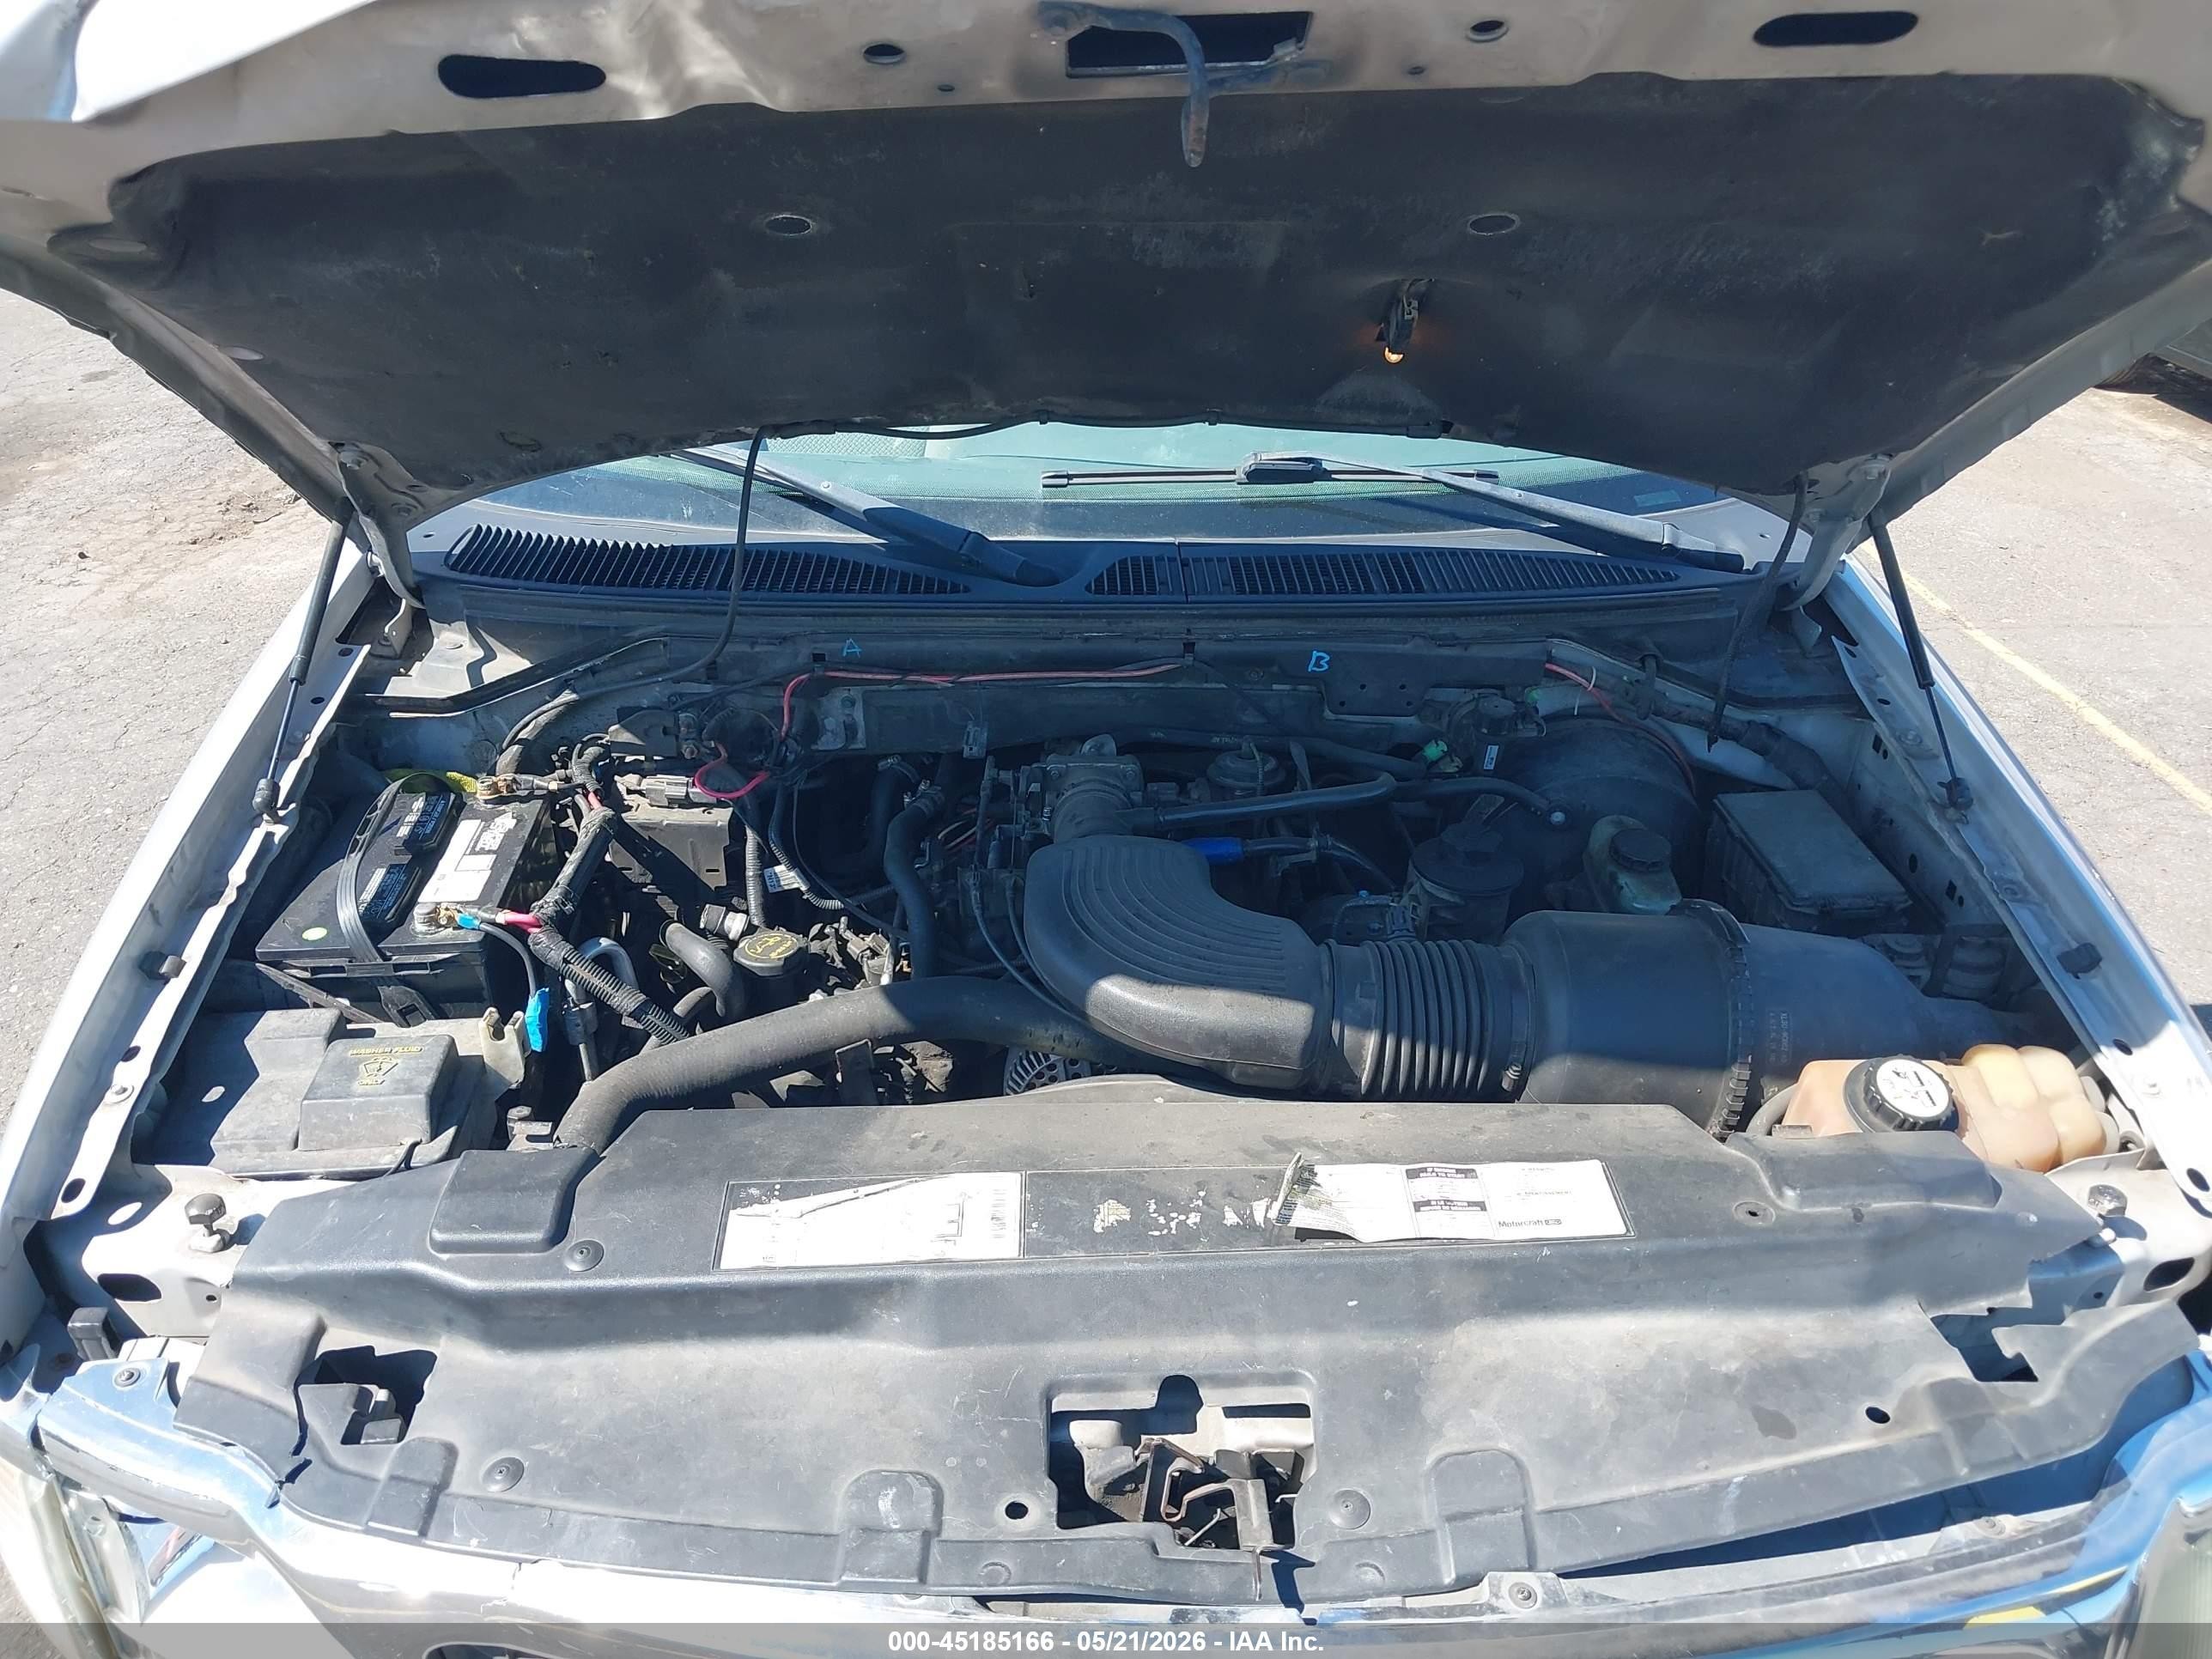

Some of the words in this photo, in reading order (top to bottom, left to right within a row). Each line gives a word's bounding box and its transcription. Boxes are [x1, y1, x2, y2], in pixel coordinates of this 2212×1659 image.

[842, 640, 861, 656] A
[1308, 650, 1330, 672] B
[394, 1046, 423, 1054] FLUID
[1498, 1219, 1544, 1228] Motorcraft
